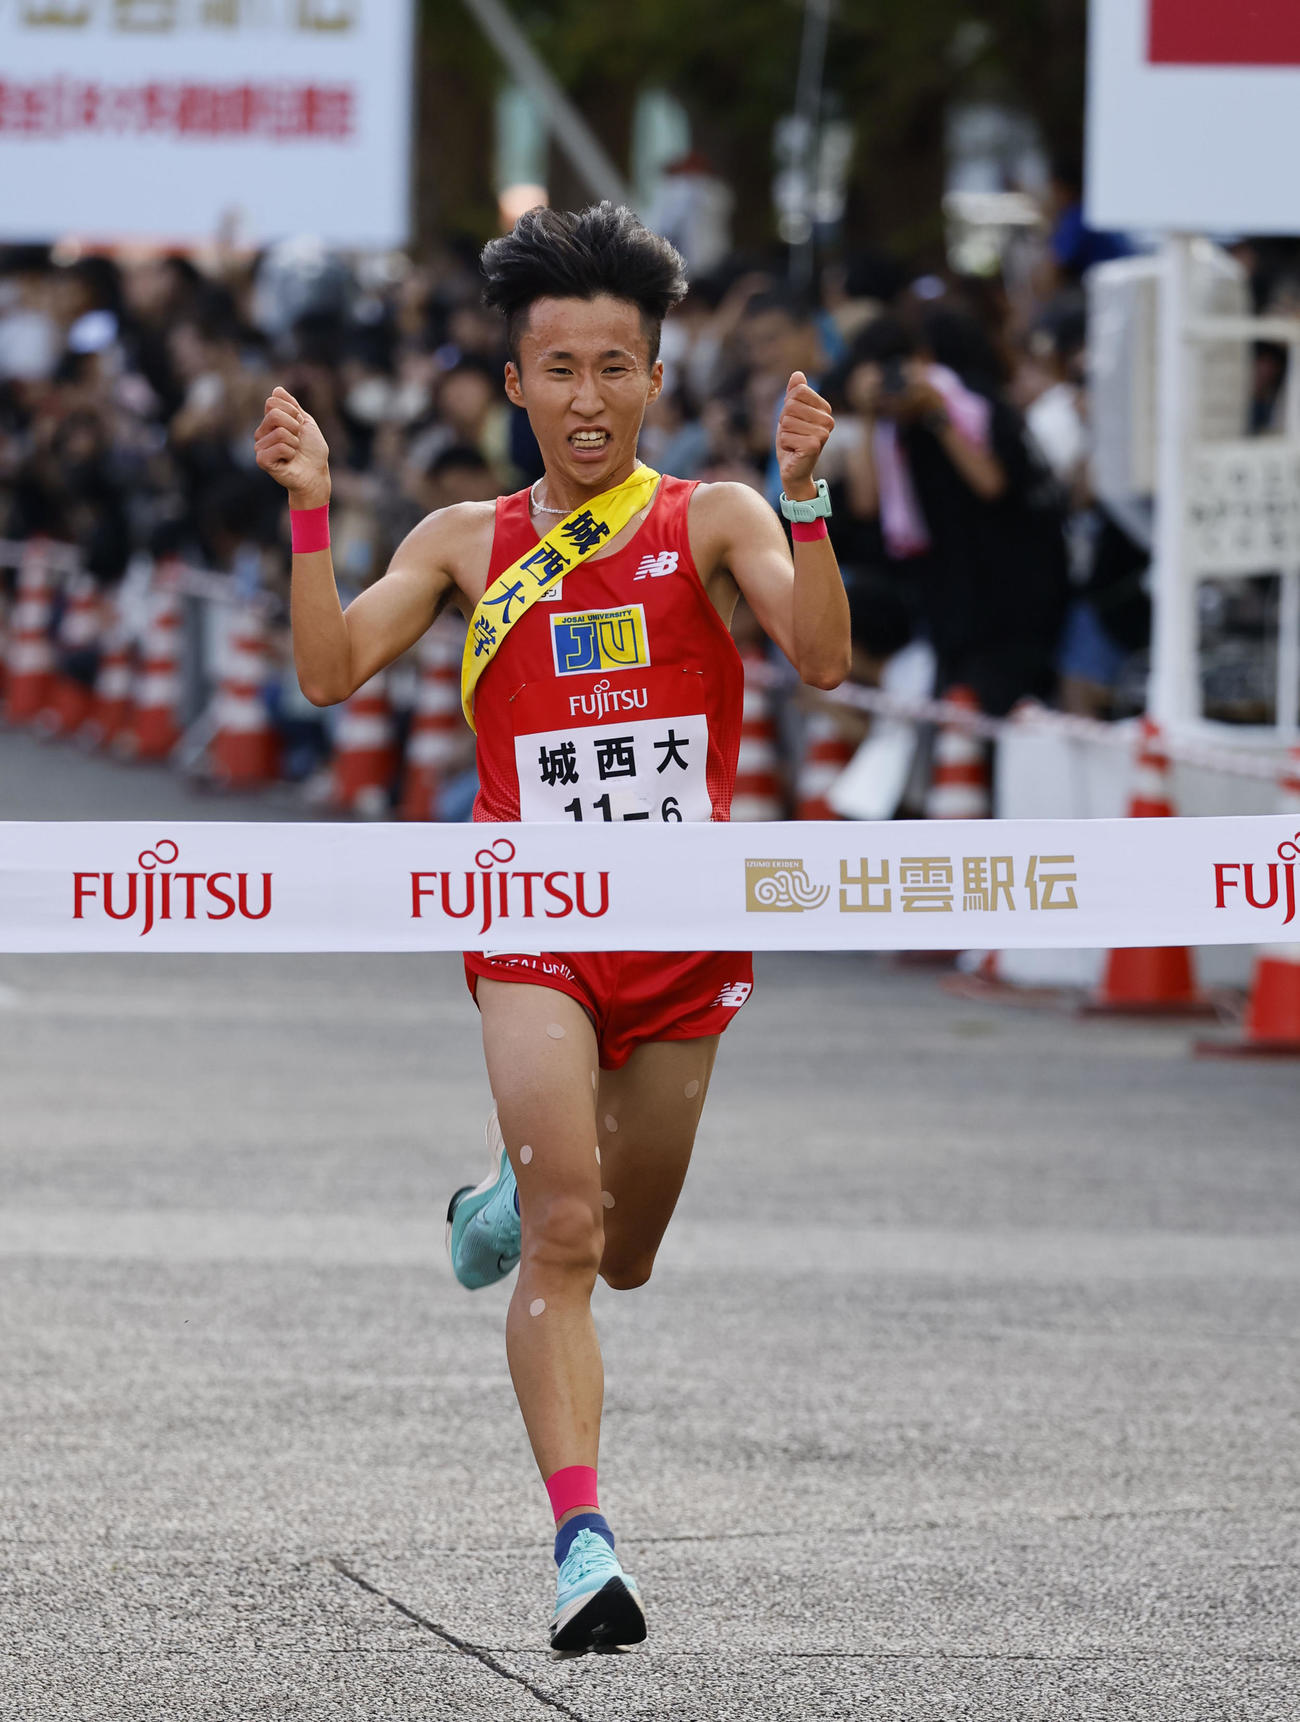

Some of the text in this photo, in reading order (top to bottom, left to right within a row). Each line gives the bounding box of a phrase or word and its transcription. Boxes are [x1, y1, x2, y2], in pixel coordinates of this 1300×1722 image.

[473, 509, 611, 657] 城西大学
[562, 610, 632, 624] JOSAI UNIVERSITY
[566, 618, 639, 670] JU
[569, 687, 648, 719] FUJITSU
[72, 871, 274, 936] FUJITSU
[410, 870, 610, 936] FUJITSU
[838, 855, 1079, 912] 出雲駅伝
[1212, 863, 1300, 926] FUJ
